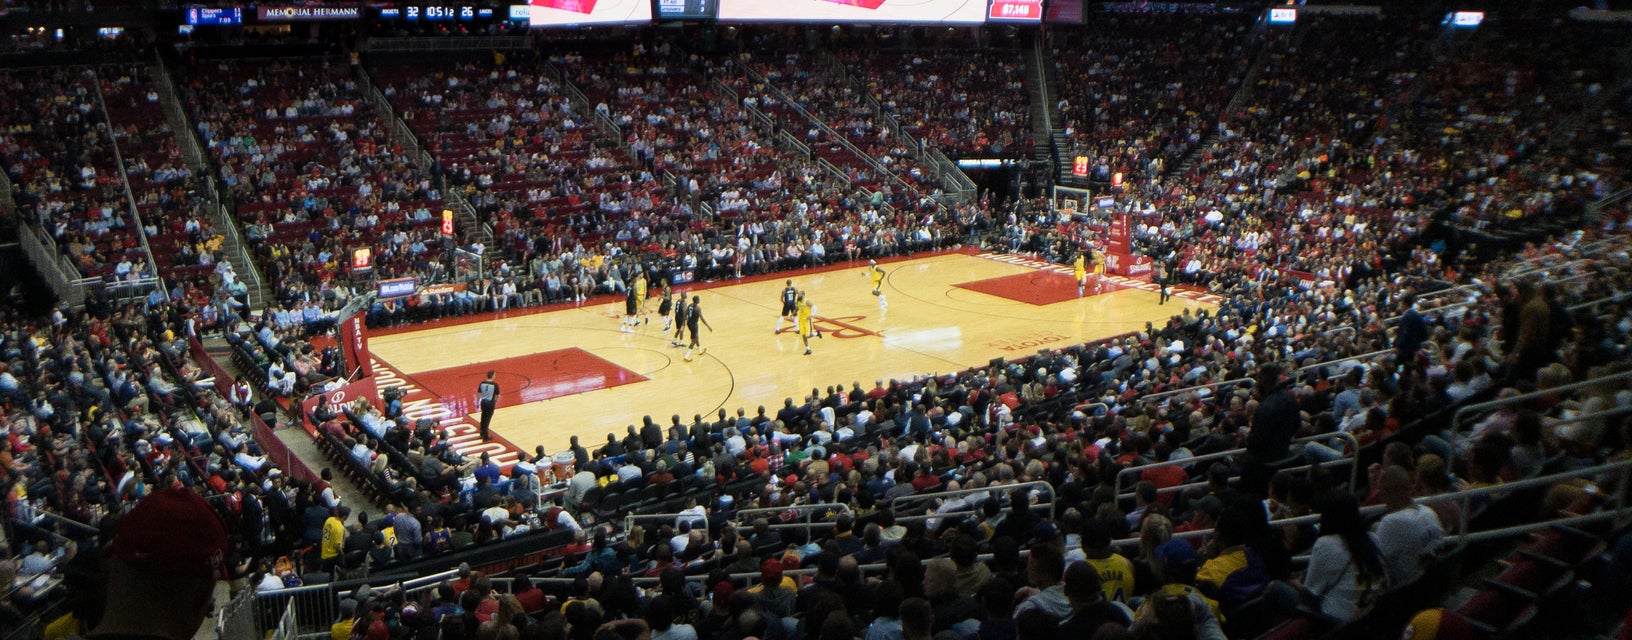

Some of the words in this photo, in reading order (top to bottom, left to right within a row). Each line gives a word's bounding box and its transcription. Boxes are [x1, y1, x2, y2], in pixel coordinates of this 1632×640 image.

[266, 7, 312, 18] MEMORIAL
[313, 8, 358, 16] HERMANN
[407, 6, 419, 17] 32
[461, 6, 474, 17] 26
[1076, 162, 1087, 173] 23
[353, 317, 362, 336] NBA
[356, 338, 364, 350] TV
